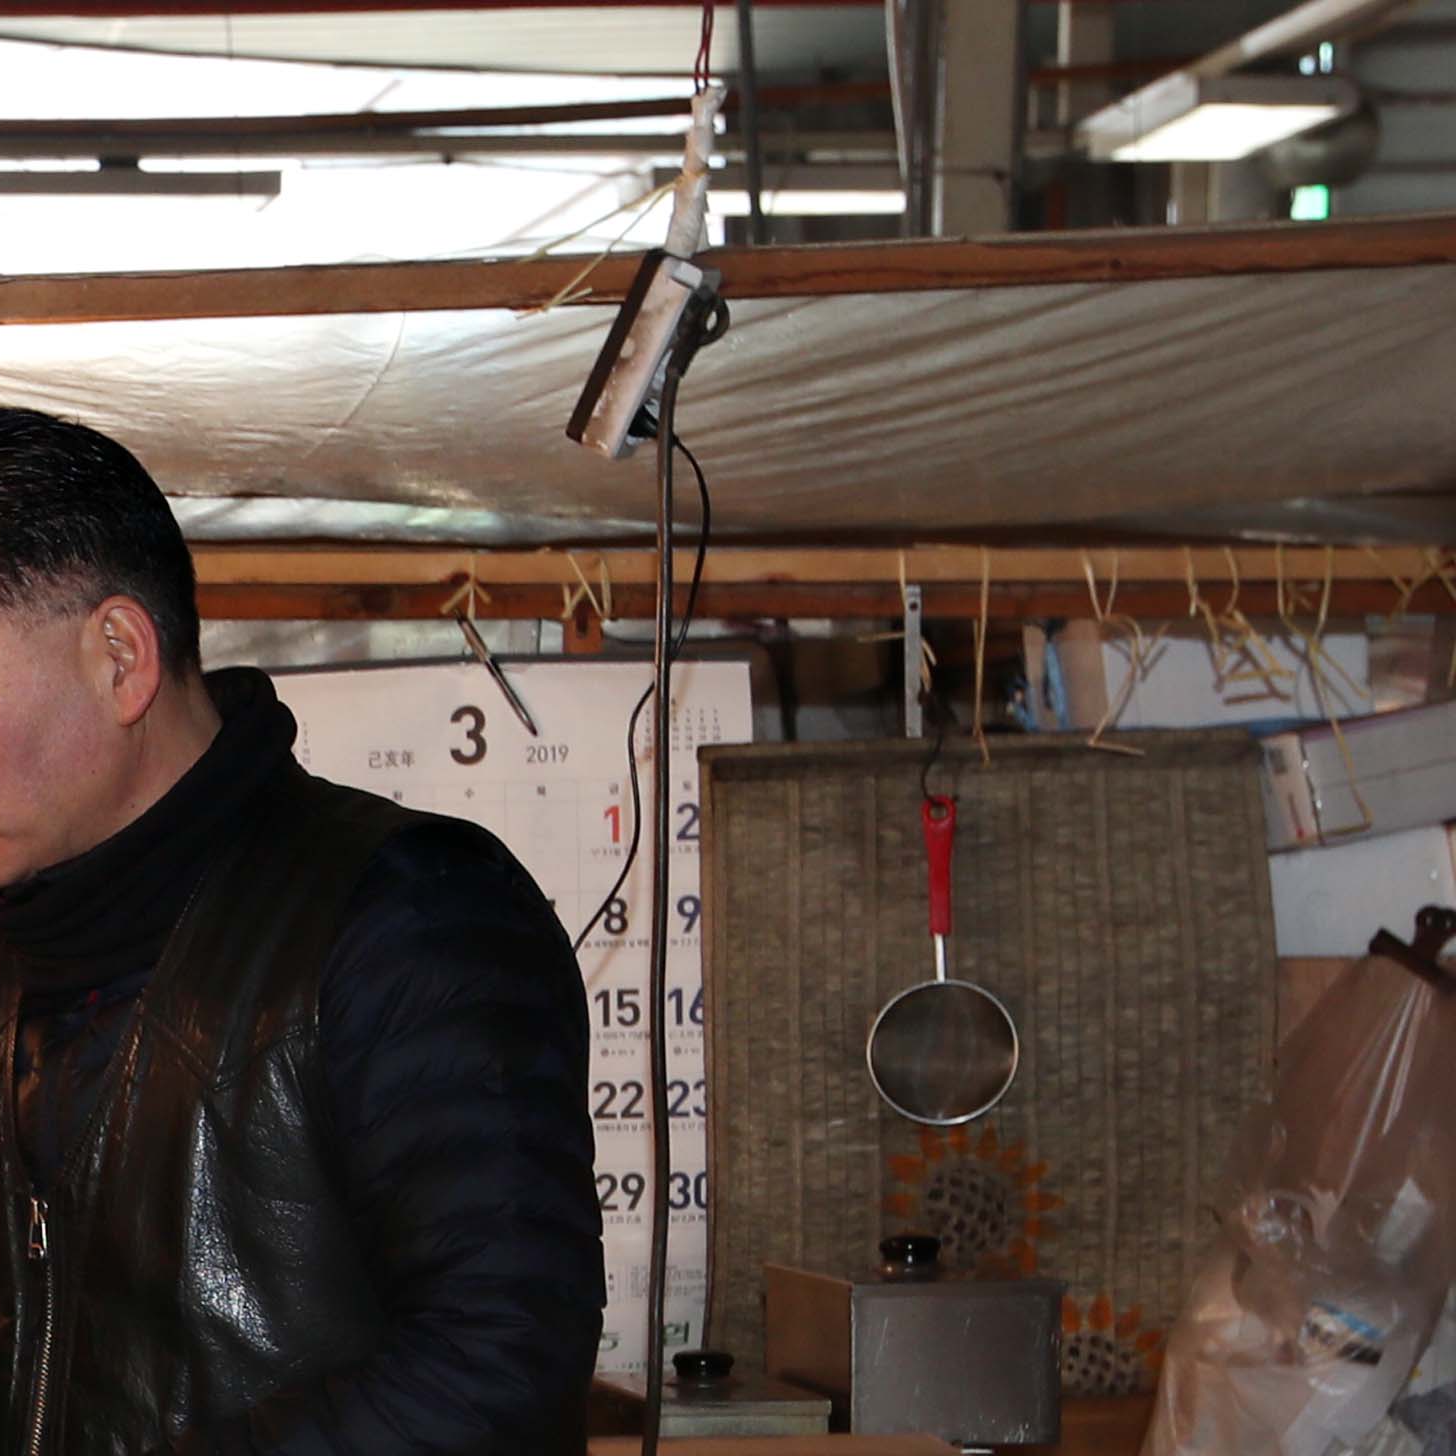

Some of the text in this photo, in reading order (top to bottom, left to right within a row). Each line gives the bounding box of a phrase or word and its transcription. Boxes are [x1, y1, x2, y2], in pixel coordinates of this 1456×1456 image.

[450, 705, 488, 766] 3
[526, 745, 569, 765] 2019
[603, 803, 700, 843] 1 2
[603, 895, 701, 935] 8 9
[594, 988, 704, 1027] 15 16
[593, 1080, 645, 1119] 22
[595, 1173, 645, 1212] 29
